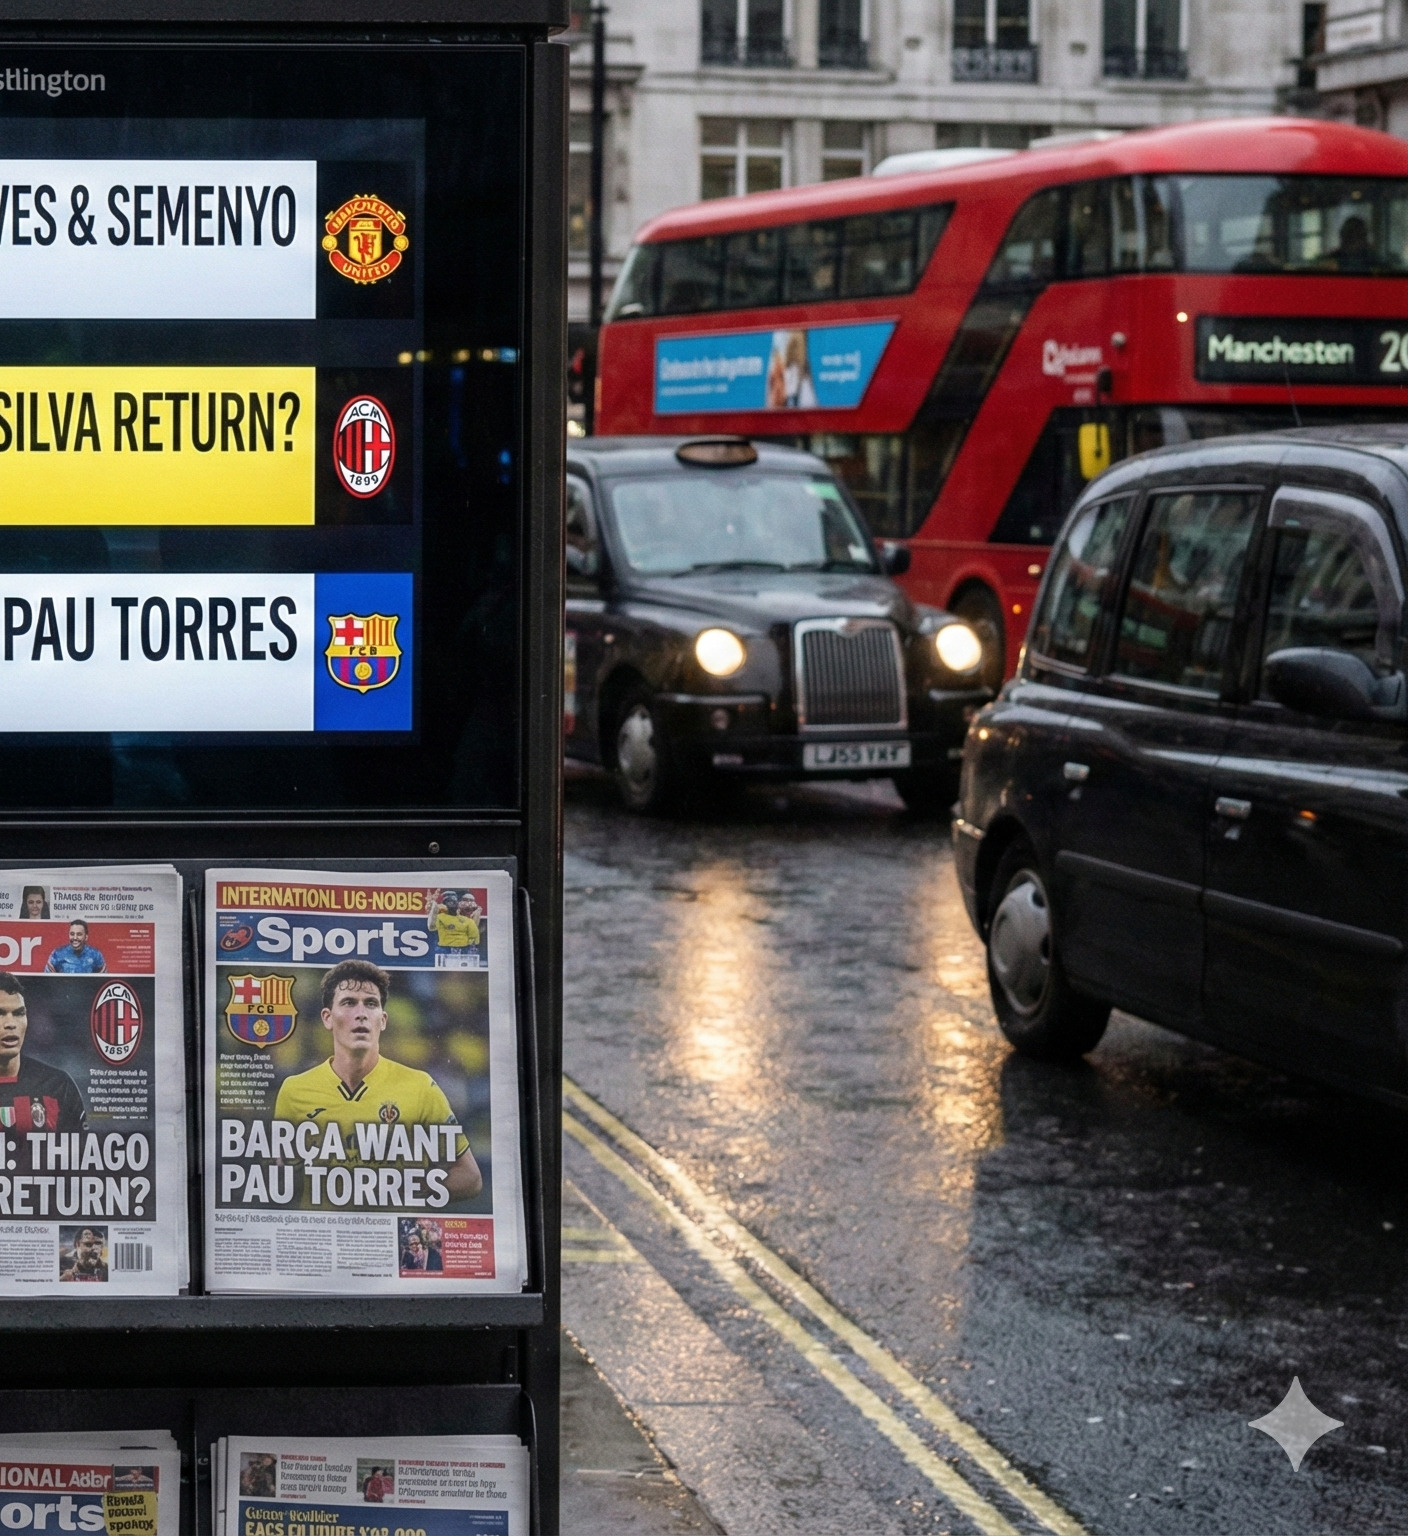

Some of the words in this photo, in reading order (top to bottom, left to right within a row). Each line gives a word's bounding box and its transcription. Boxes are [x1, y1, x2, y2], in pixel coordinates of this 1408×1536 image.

[67, 184, 98, 247] &
[107, 184, 297, 248] SEMENYO
[113, 391, 301, 453] RETURN?
[347, 403, 382, 423] ACM
[349, 473, 379, 486] 1899
[3, 596, 95, 662] PAU
[110, 595, 298, 662] TORRES
[255, 915, 430, 962] Sports
[26, 1132, 150, 1172] THIAGO
[220, 1118, 347, 1167] BARÇA
[354, 1122, 463, 1163] WANT
[220, 1163, 295, 1204] PAU
[304, 1166, 450, 1208] TORRES
